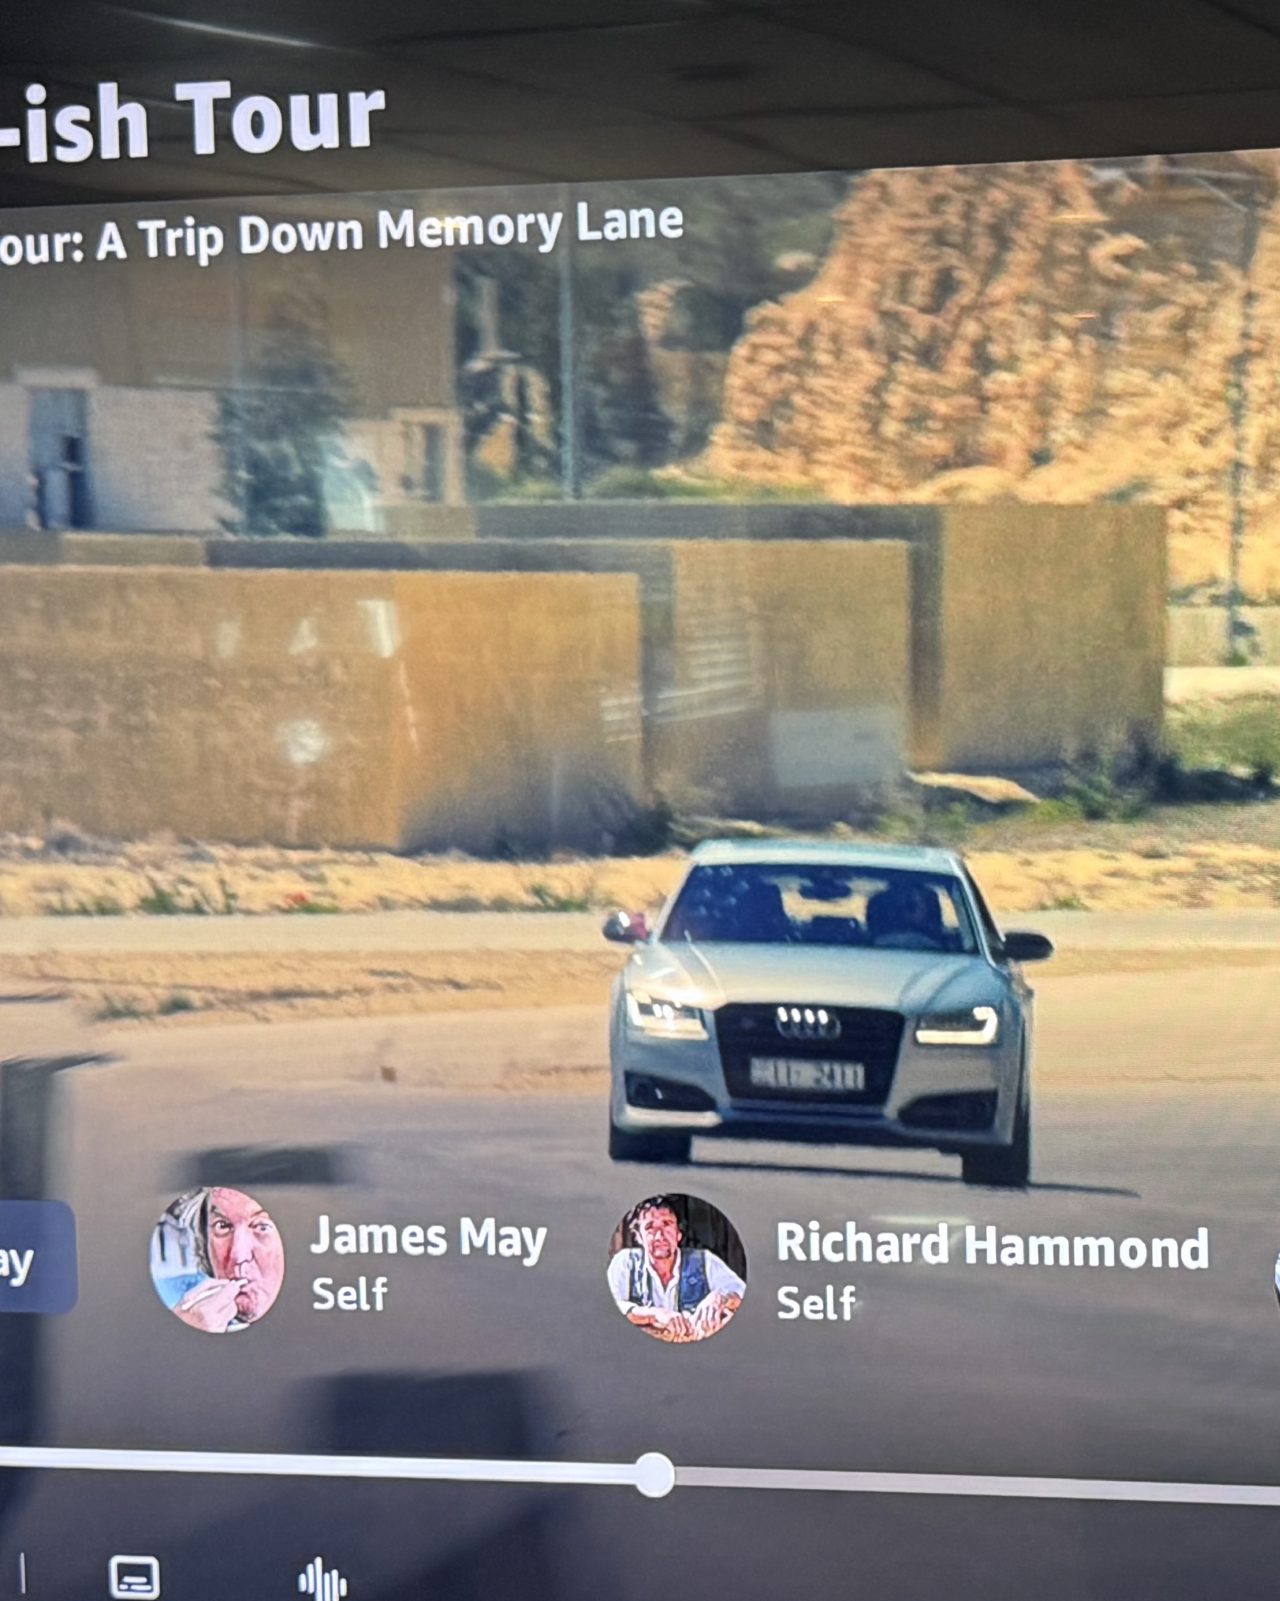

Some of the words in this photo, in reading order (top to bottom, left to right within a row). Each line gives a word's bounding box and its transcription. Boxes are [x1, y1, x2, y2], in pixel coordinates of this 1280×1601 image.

[174, 80, 386, 155] Tour
[96, 221, 128, 261] A
[137, 214, 224, 267] Trip
[239, 214, 363, 255] Down
[378, 207, 563, 254] Memory
[577, 201, 684, 242] Lane
[309, 1214, 448, 1256] James
[460, 1216, 548, 1268] May
[777, 1220, 949, 1265] Richard
[965, 1224, 1209, 1270] Hammond
[312, 1275, 388, 1312] Self
[777, 1285, 856, 1321] Self
